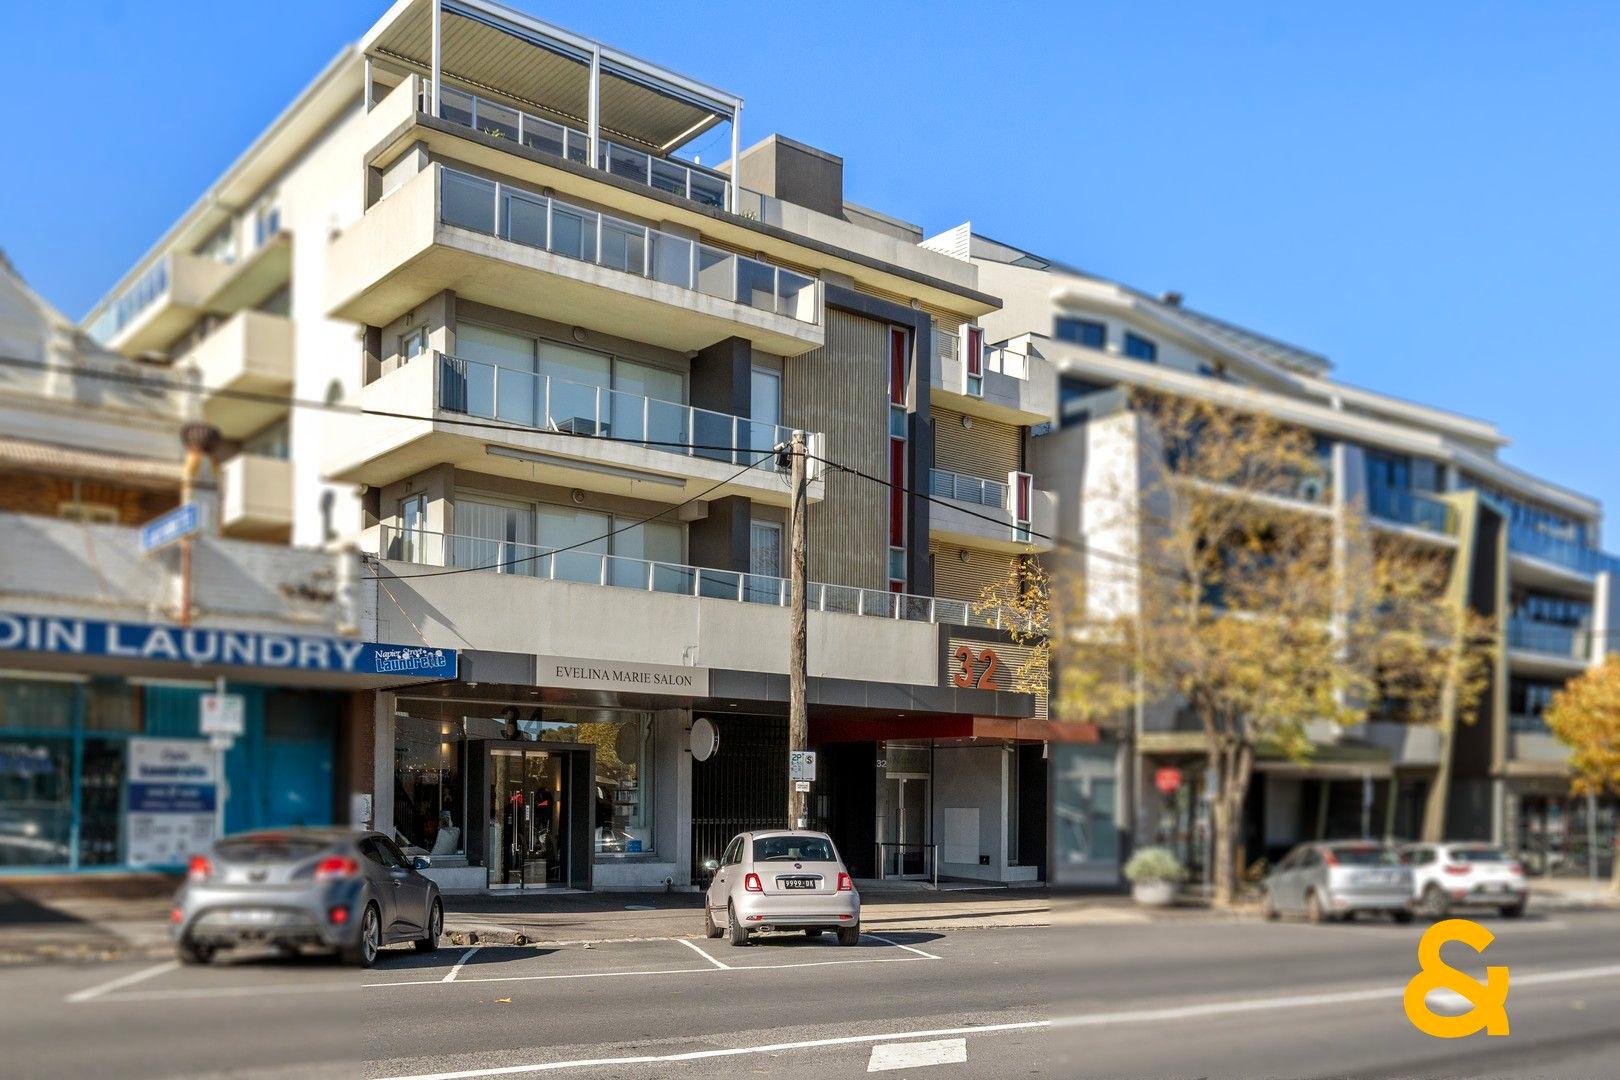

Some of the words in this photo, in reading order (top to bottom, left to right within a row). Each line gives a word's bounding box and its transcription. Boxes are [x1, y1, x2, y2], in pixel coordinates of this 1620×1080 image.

[105, 622, 364, 670] LAUNDRY
[375, 649, 401, 660] Napier
[376, 652, 446, 672] Laundrette
[954, 646, 997, 690] 32
[556, 666, 610, 680] EVELINA
[612, 670, 651, 684] MARIE
[653, 674, 692, 686] SALON
[876, 759, 888, 767] 32
